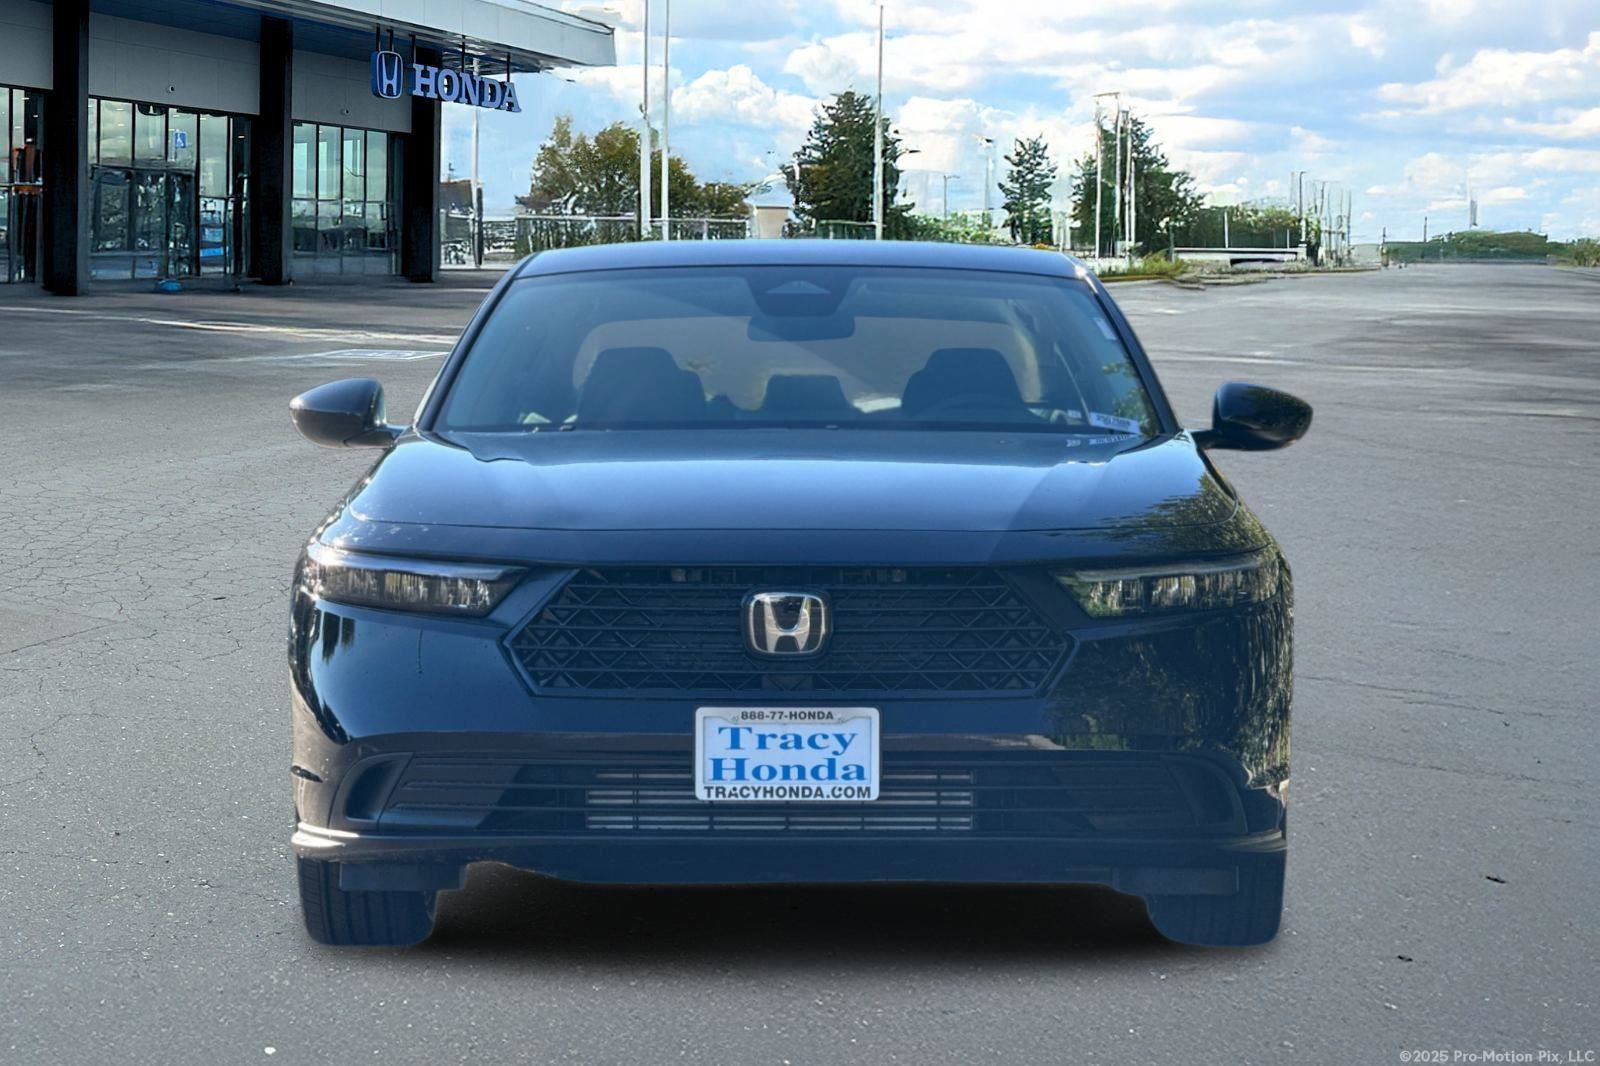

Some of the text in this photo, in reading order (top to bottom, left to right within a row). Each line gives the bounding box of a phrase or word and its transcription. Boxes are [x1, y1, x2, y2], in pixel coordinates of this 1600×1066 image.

[412, 63, 522, 113] HONDA
[741, 711, 834, 721] 888-77-HONDA
[718, 726, 858, 756] Tracy
[709, 757, 867, 782] Honda
[704, 786, 871, 799] TRACYHONDA.COM
